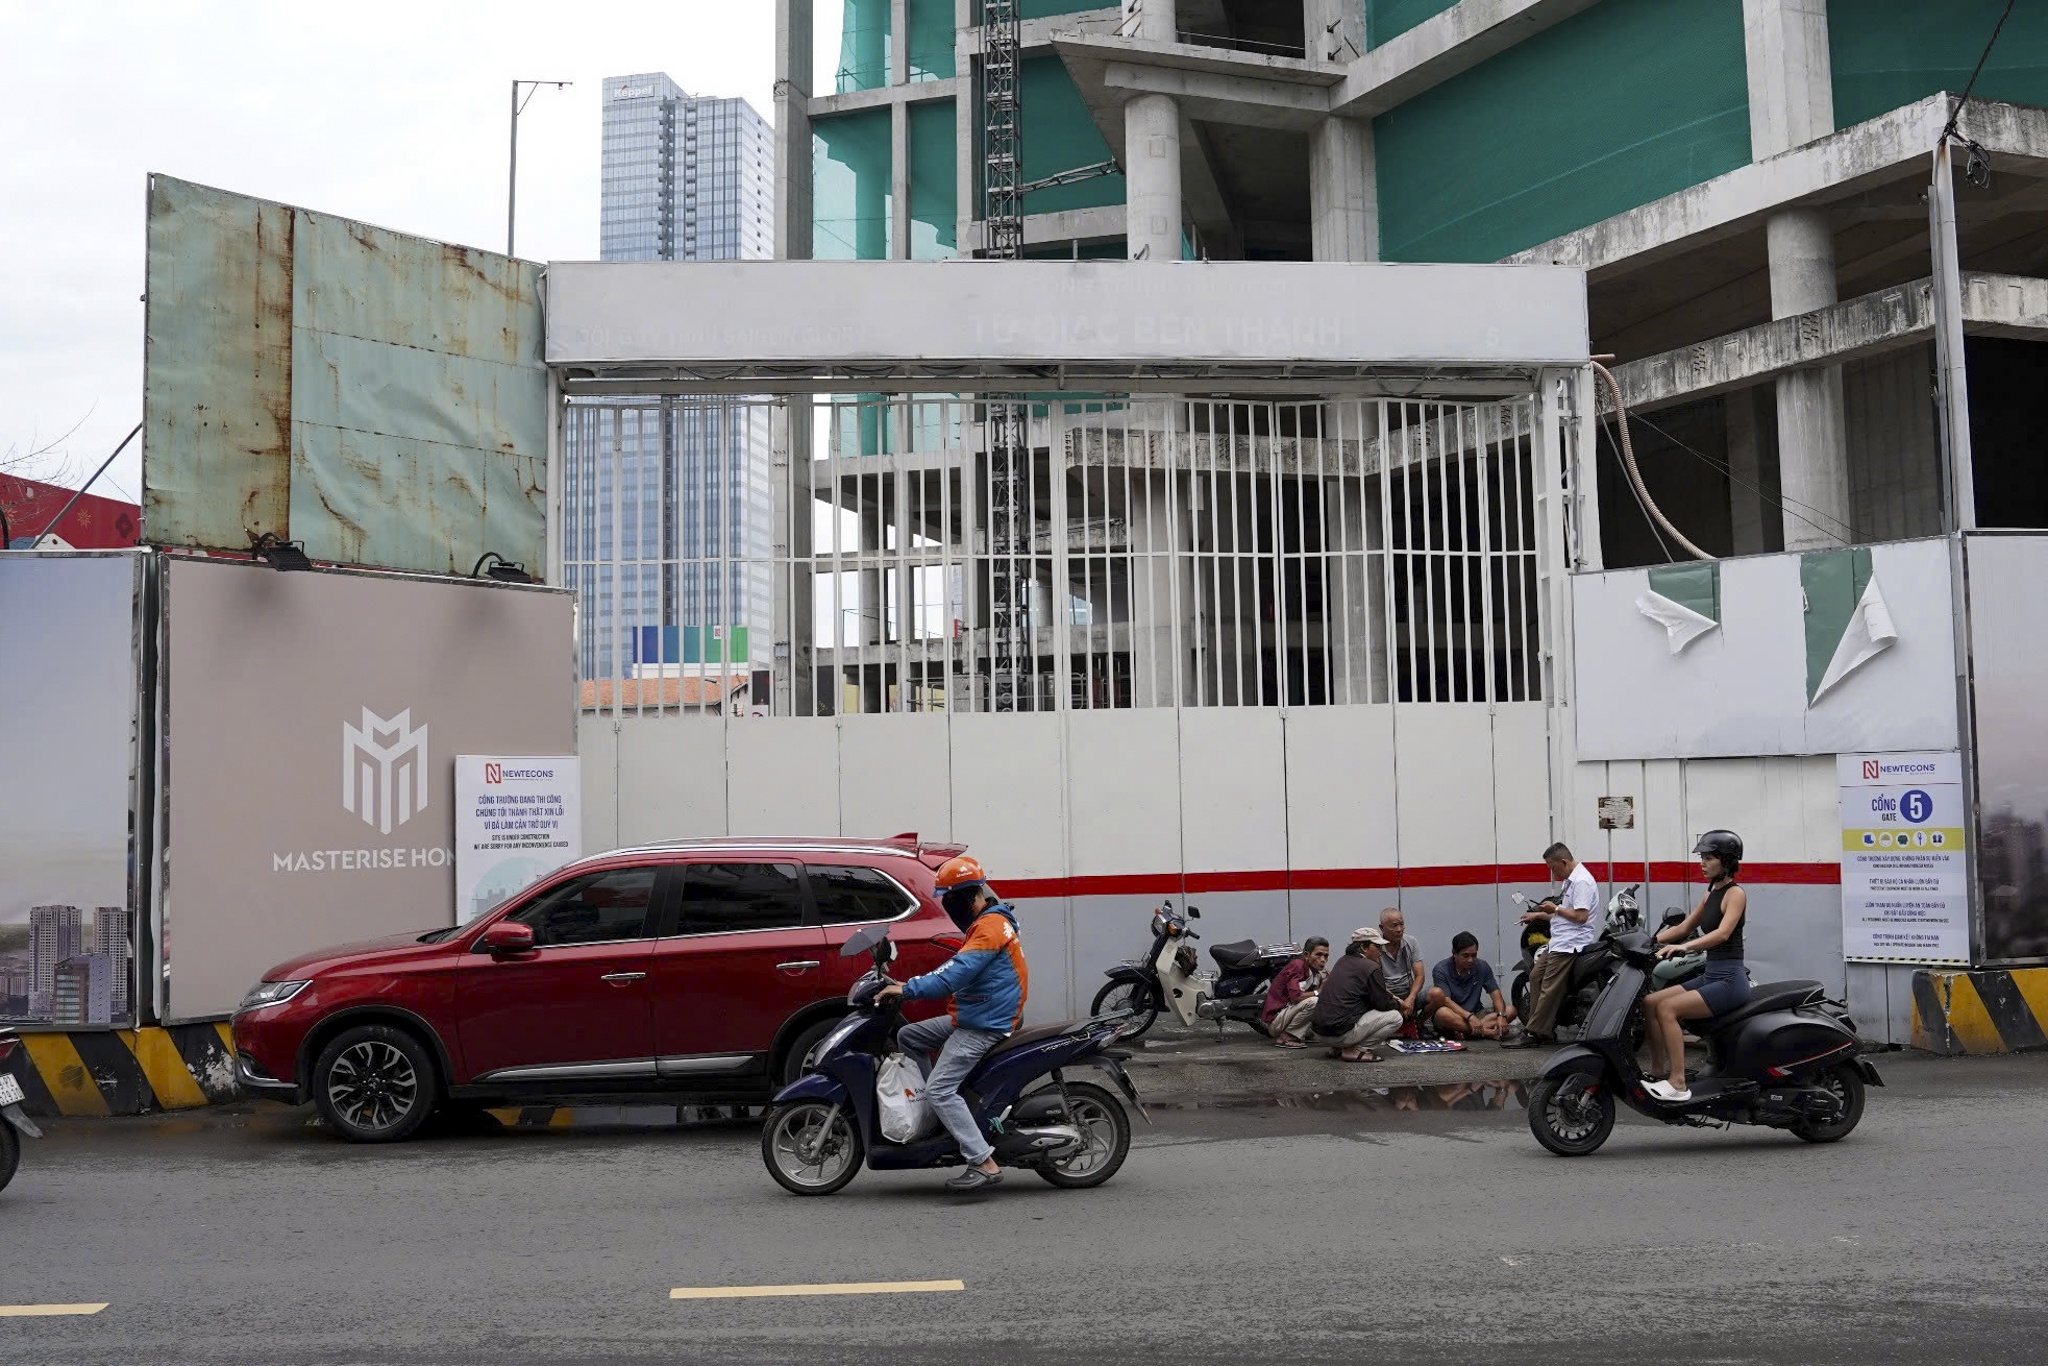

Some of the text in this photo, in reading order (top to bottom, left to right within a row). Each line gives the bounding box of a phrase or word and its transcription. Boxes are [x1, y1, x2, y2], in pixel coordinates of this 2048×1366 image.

[1880, 764, 1936, 773] NEWTECONS
[502, 770, 554, 778] NEWTECONS
[478, 794, 495, 804] CÔNG
[537, 795, 546, 803] THI
[547, 794, 562, 804] CÔNG
[1871, 793, 1897, 811] CỔNG
[475, 807, 497, 817] CHÚNG
[544, 808, 554, 816] XIN
[1909, 794, 1923, 820] 5
[1881, 813, 1897, 821] GATE
[273, 850, 406, 872] MASTERISE
